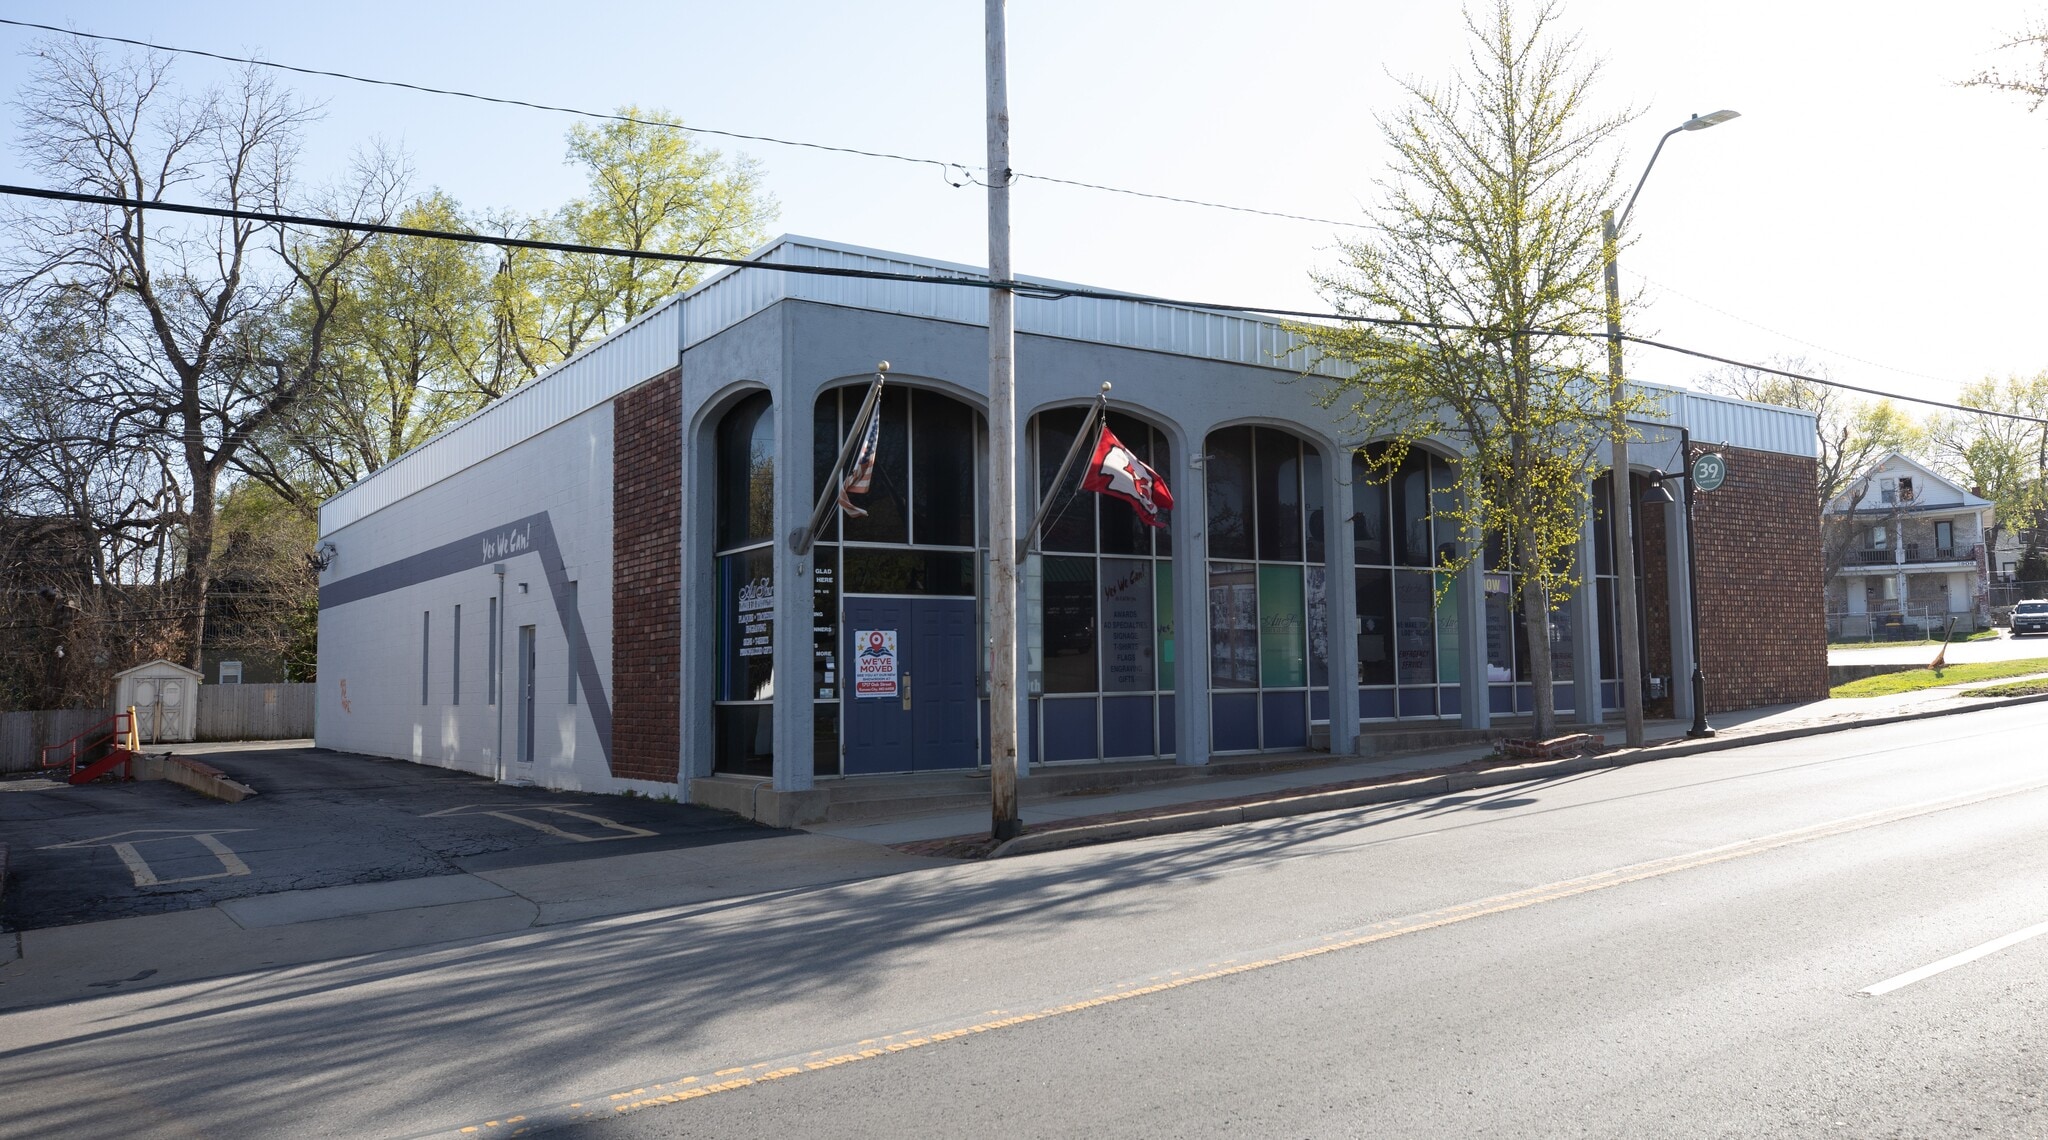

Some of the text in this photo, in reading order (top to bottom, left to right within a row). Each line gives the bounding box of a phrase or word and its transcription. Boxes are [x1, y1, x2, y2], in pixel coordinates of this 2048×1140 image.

[1699, 462, 1719, 479] 39
[482, 538, 496, 563] Yes
[496, 532, 509, 557] We
[1104, 586, 1117, 602] Yes
[1117, 576, 1129, 592] We
[1113, 610, 1137, 618] AWARDS
[1103, 621, 1112, 629] AD
[1113, 632, 1138, 640] SIGNAGE
[1113, 643, 1138, 651] T-SHIRTS
[861, 665, 893, 673] MOVED
